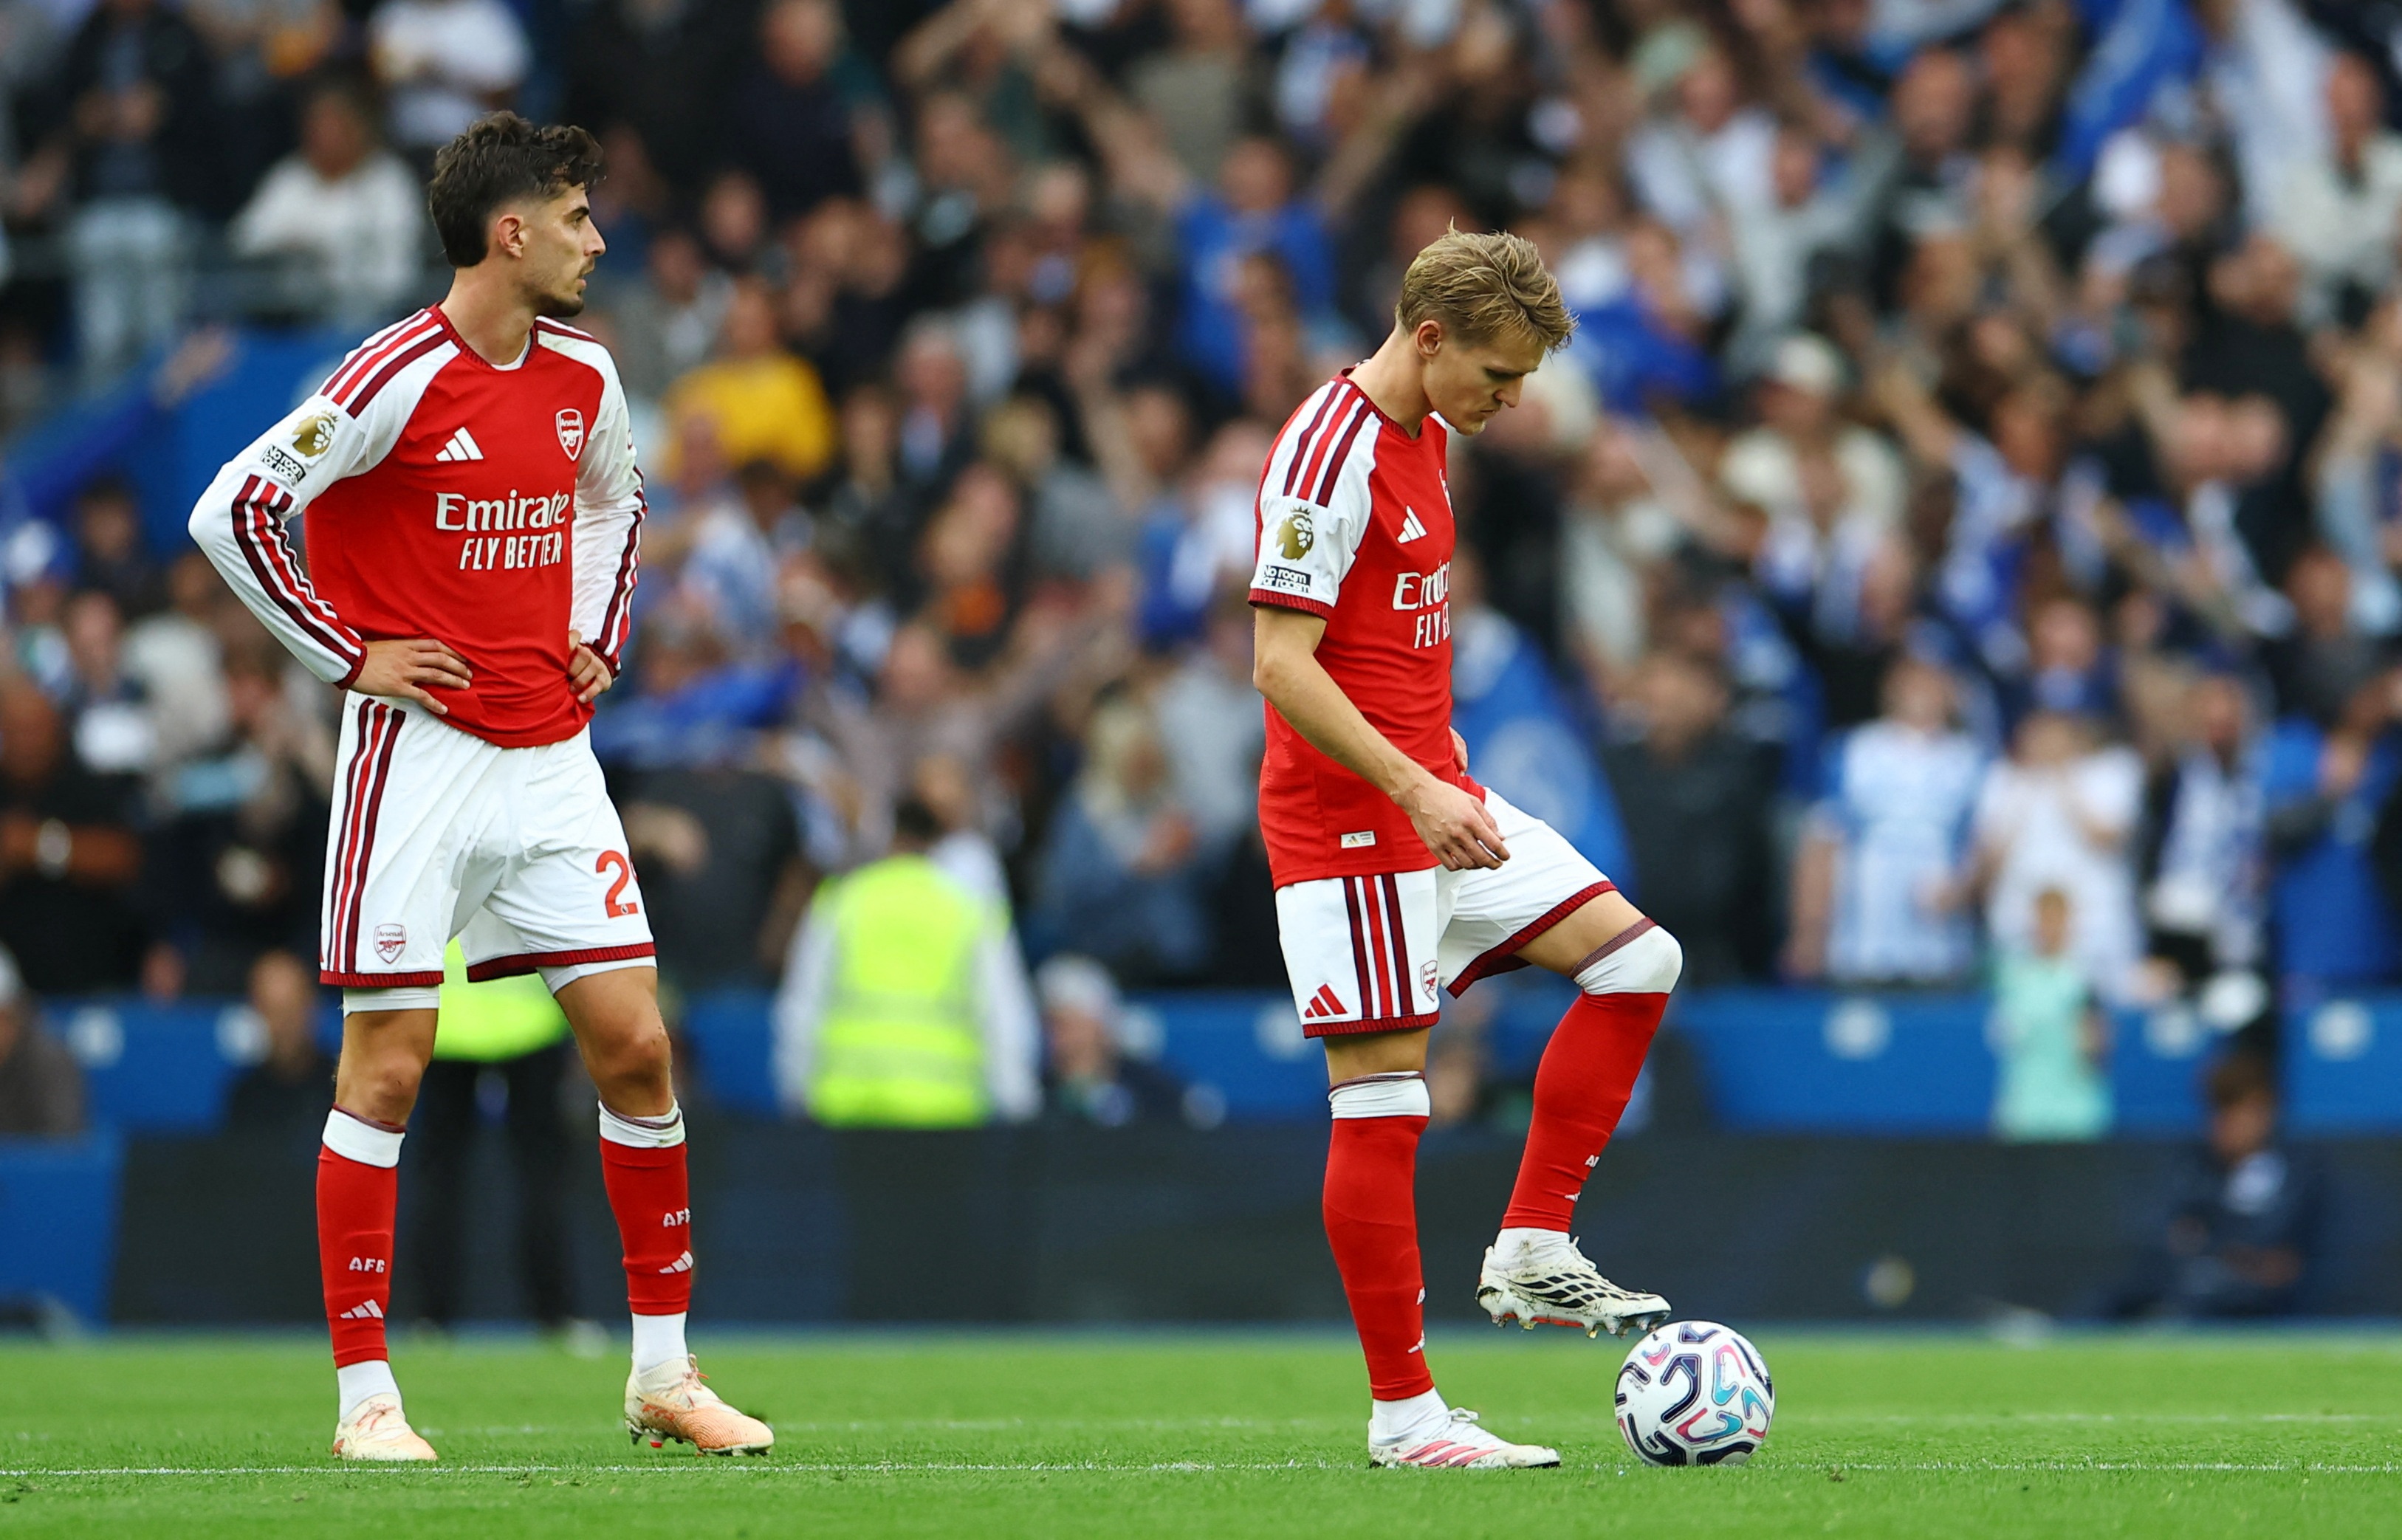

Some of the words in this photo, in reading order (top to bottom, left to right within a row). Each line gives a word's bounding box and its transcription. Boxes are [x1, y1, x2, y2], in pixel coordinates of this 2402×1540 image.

[560, 419, 580, 427] Arsenal
[267, 444, 282, 461] No
[436, 489, 570, 532] Emirate
[459, 537, 501, 570] FLY
[504, 531, 563, 569] BETTER
[1263, 565, 1277, 577] No
[1277, 568, 1307, 584] room
[1414, 611, 1441, 649] FLY
[595, 850, 639, 918] 2
